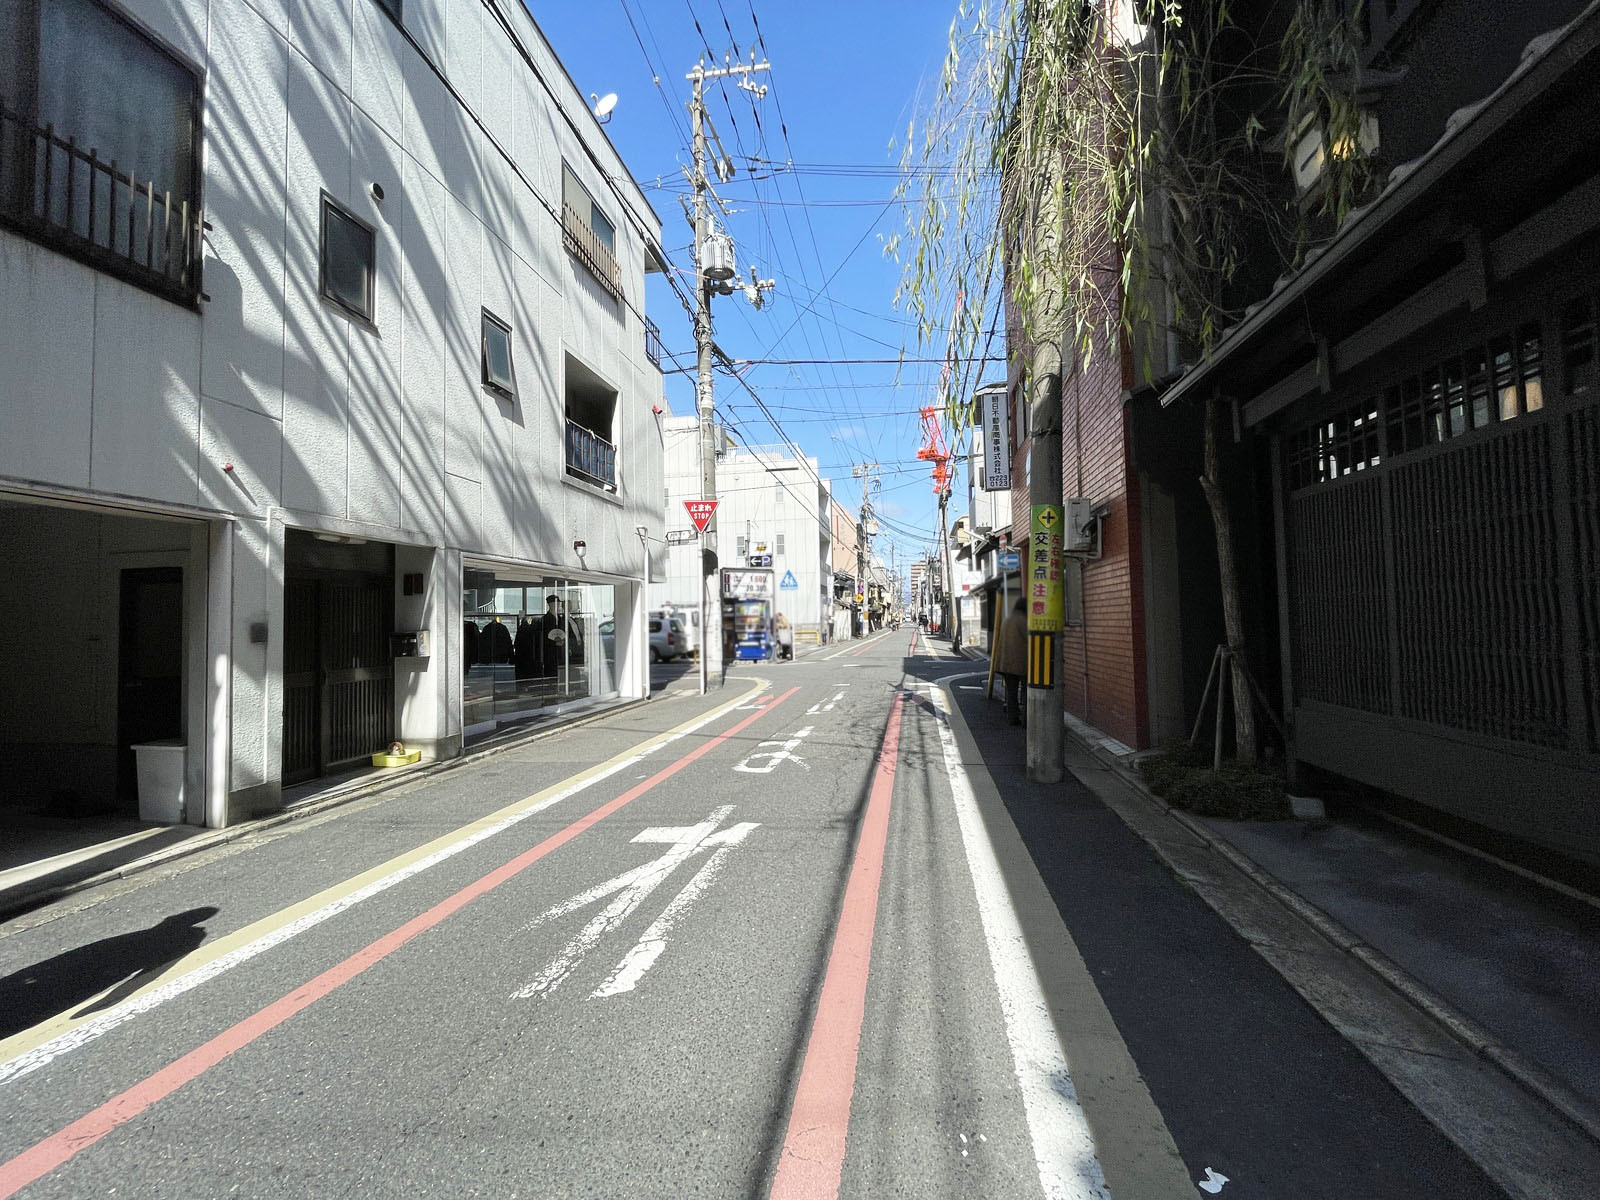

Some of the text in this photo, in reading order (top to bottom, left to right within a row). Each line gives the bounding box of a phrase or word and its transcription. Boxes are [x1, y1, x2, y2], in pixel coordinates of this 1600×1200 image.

[690, 504, 712, 512] 止まれ
[761, 556, 771, 566] P
[1032, 531, 1049, 615] 交差点注意
